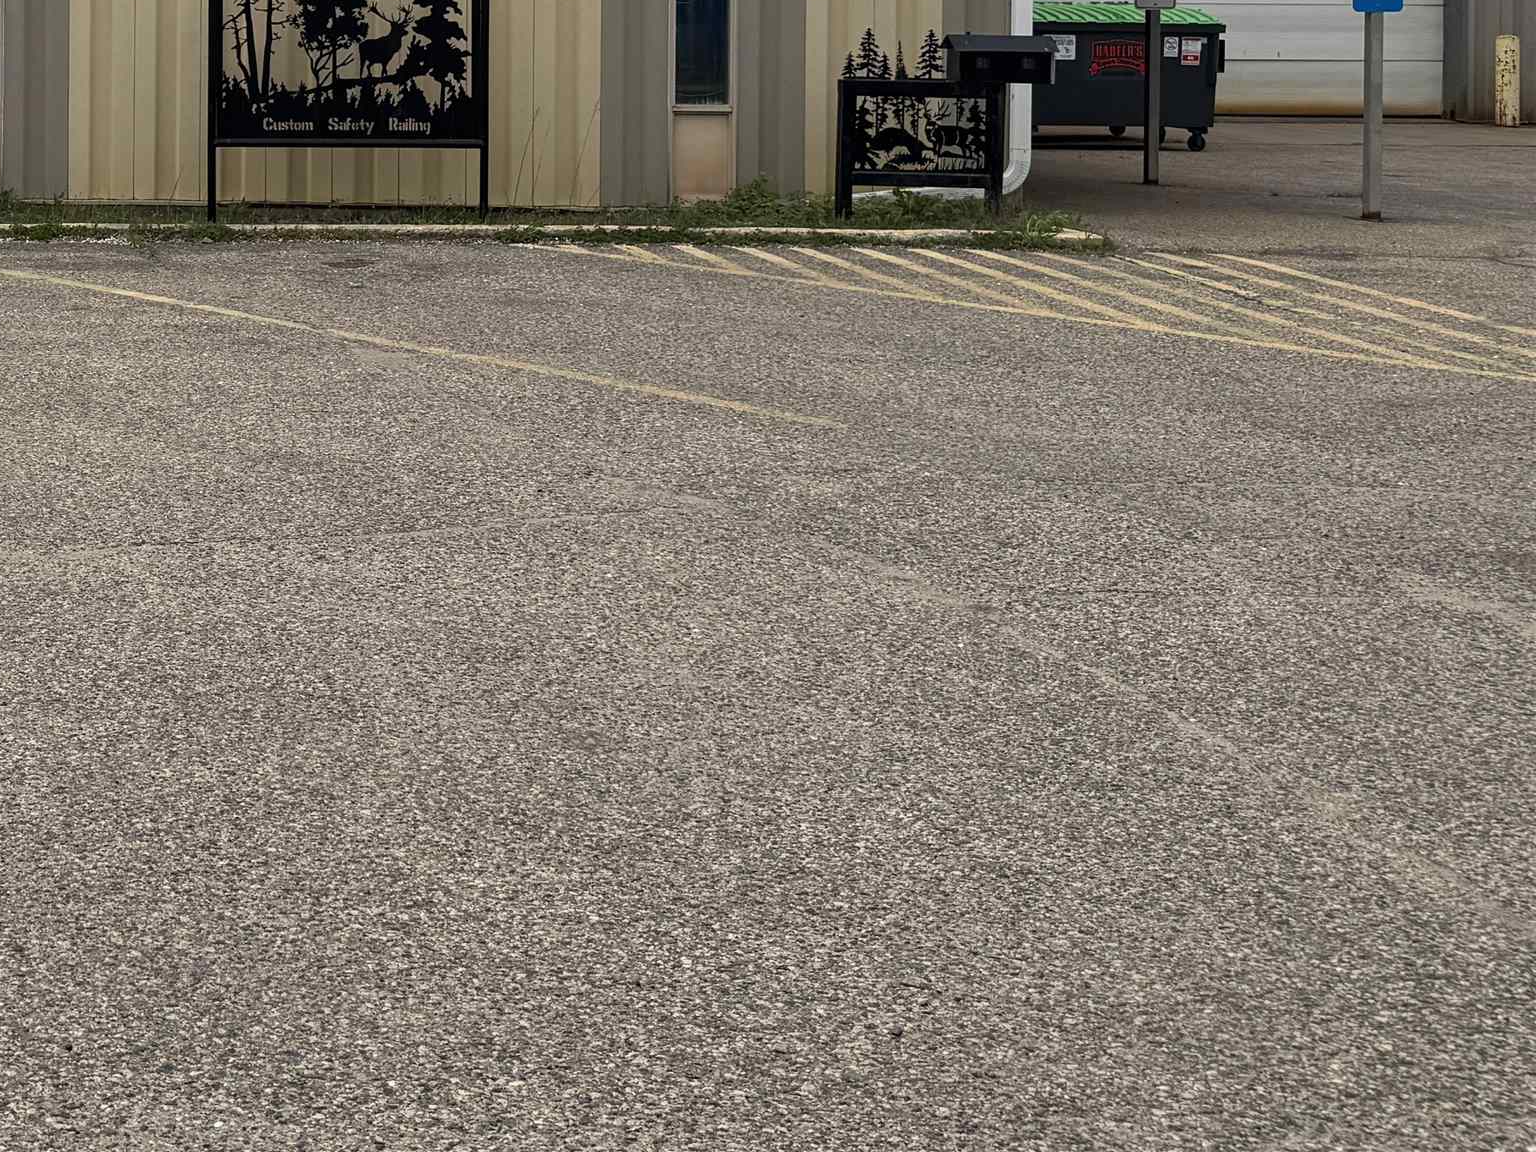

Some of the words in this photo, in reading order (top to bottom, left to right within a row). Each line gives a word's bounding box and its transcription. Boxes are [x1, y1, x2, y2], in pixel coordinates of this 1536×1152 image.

[263, 117, 314, 132] Custom
[328, 117, 375, 136] Safety
[388, 117, 432, 136] Railing
